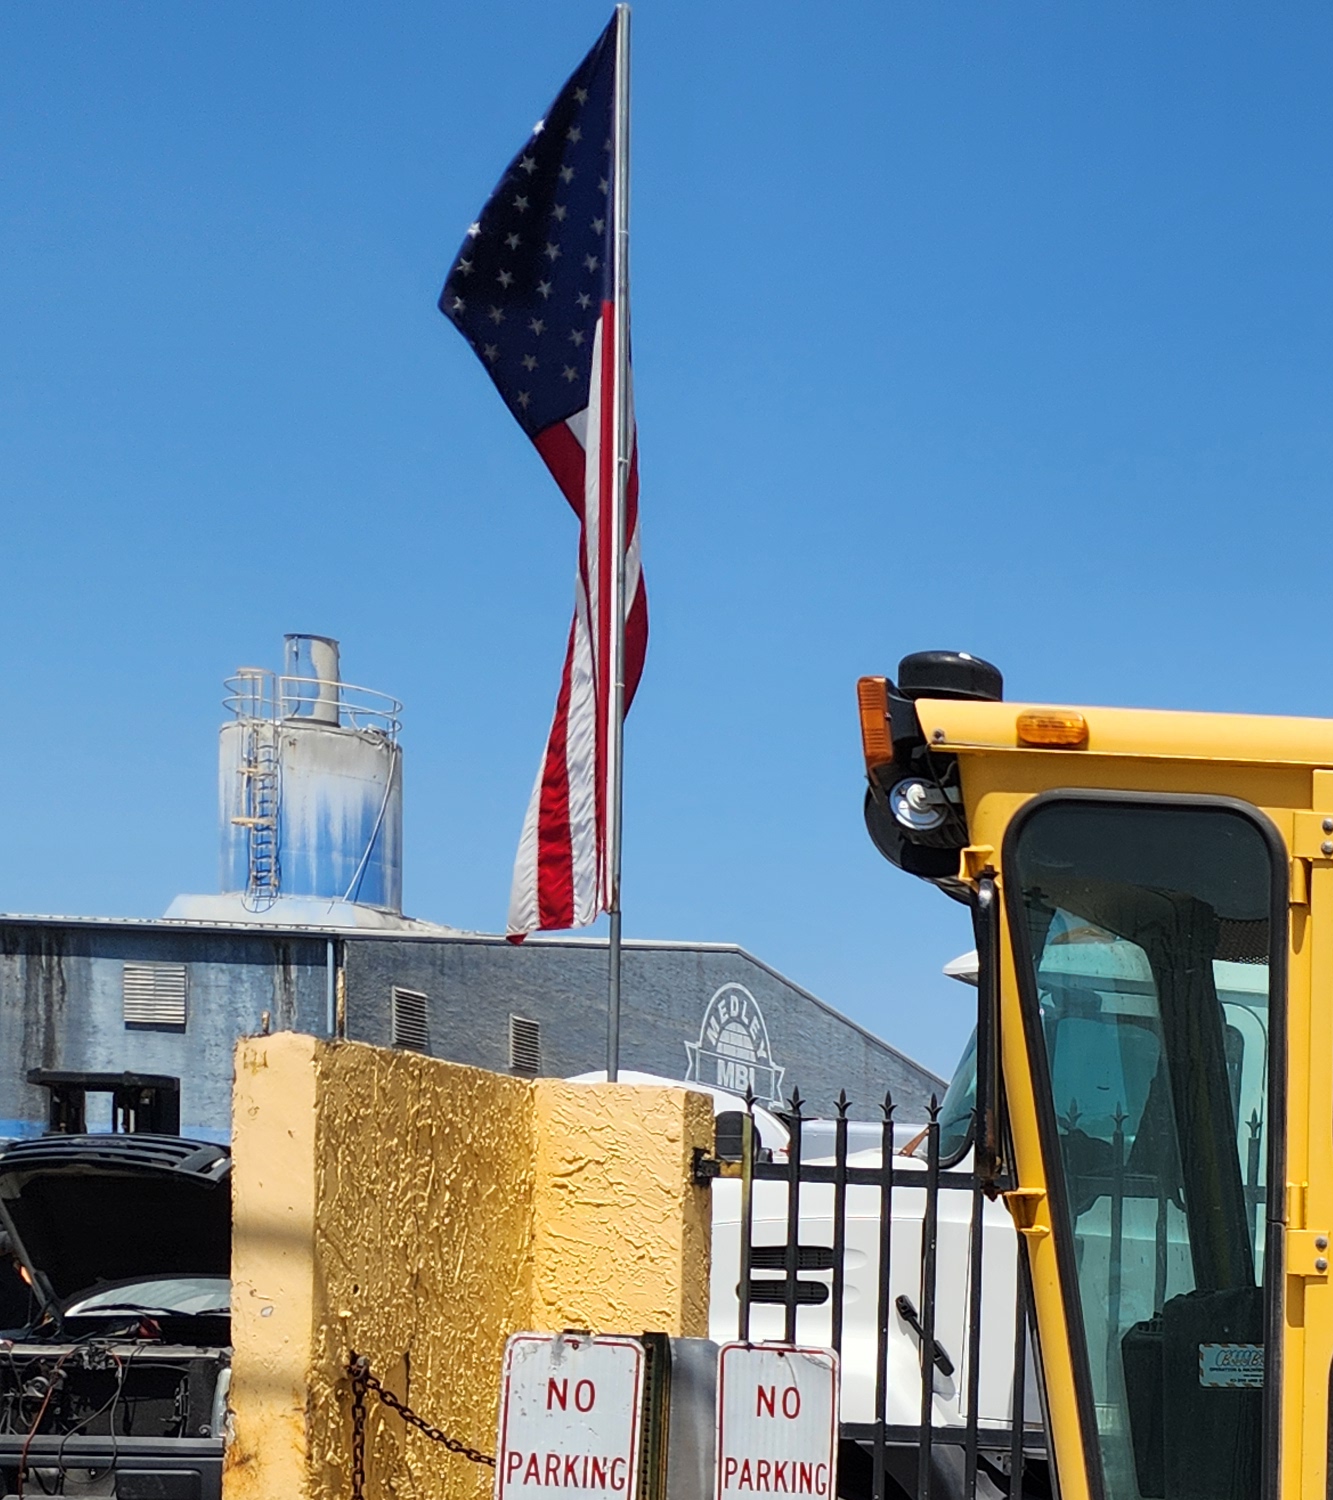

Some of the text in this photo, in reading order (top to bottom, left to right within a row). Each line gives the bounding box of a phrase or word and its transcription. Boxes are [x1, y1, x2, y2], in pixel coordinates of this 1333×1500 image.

[706, 995, 768, 1059] MEDLEY
[717, 1059, 755, 1095] MBI
[547, 1377, 596, 1412] NO
[756, 1385, 802, 1419] NO
[506, 1451, 627, 1491] PARKING
[724, 1457, 827, 1495] PARKING
